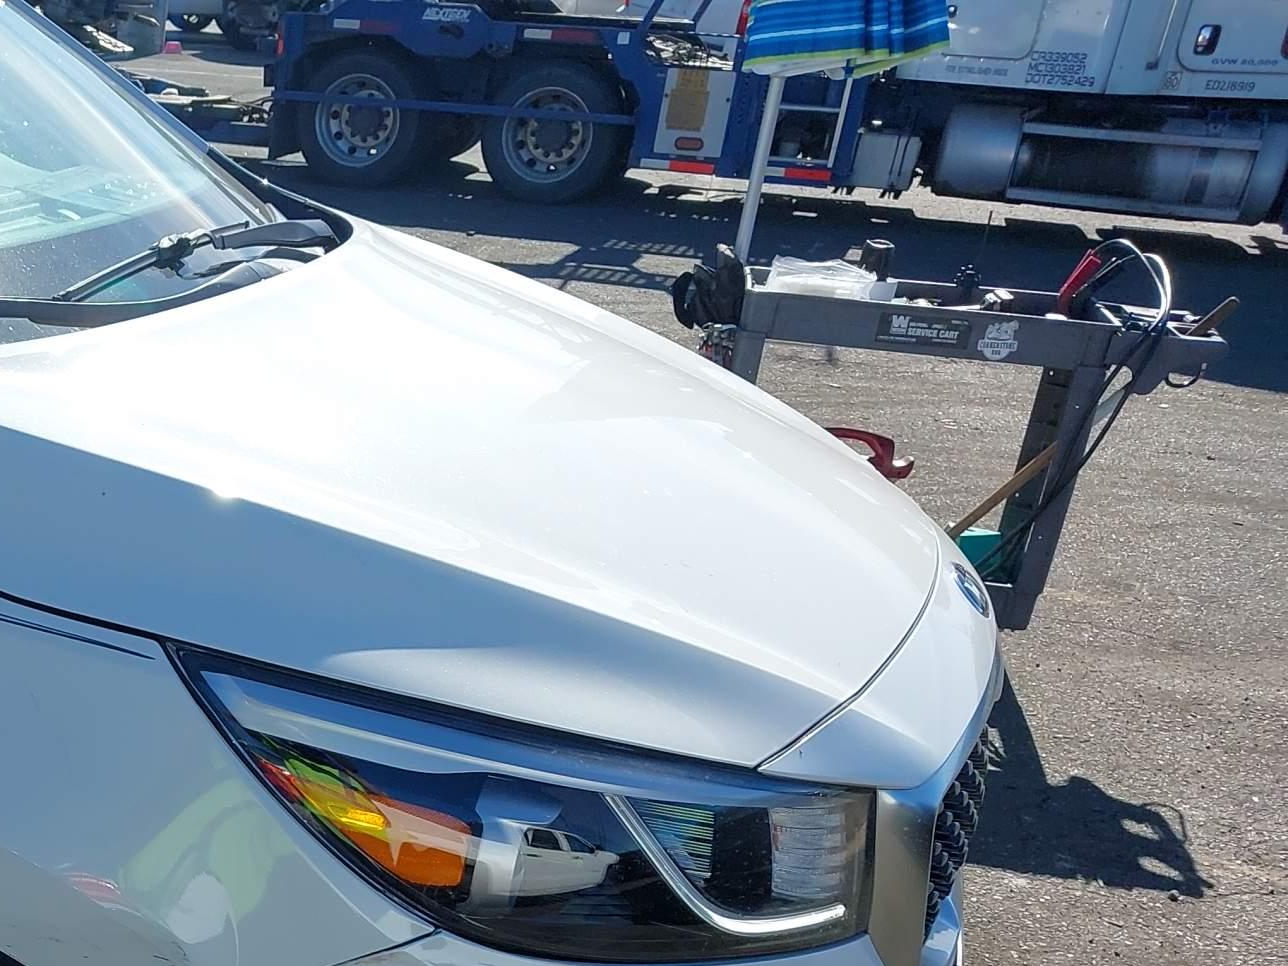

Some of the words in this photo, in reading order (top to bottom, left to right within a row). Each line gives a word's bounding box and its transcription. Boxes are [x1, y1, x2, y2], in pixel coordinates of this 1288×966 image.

[1211, 57, 1238, 66] GVW
[1027, 61, 1086, 76] MC1303821
[1024, 72, 1096, 88] DOT2752429
[907, 328, 939, 338] SERVICE
[939, 330, 960, 339] CART
